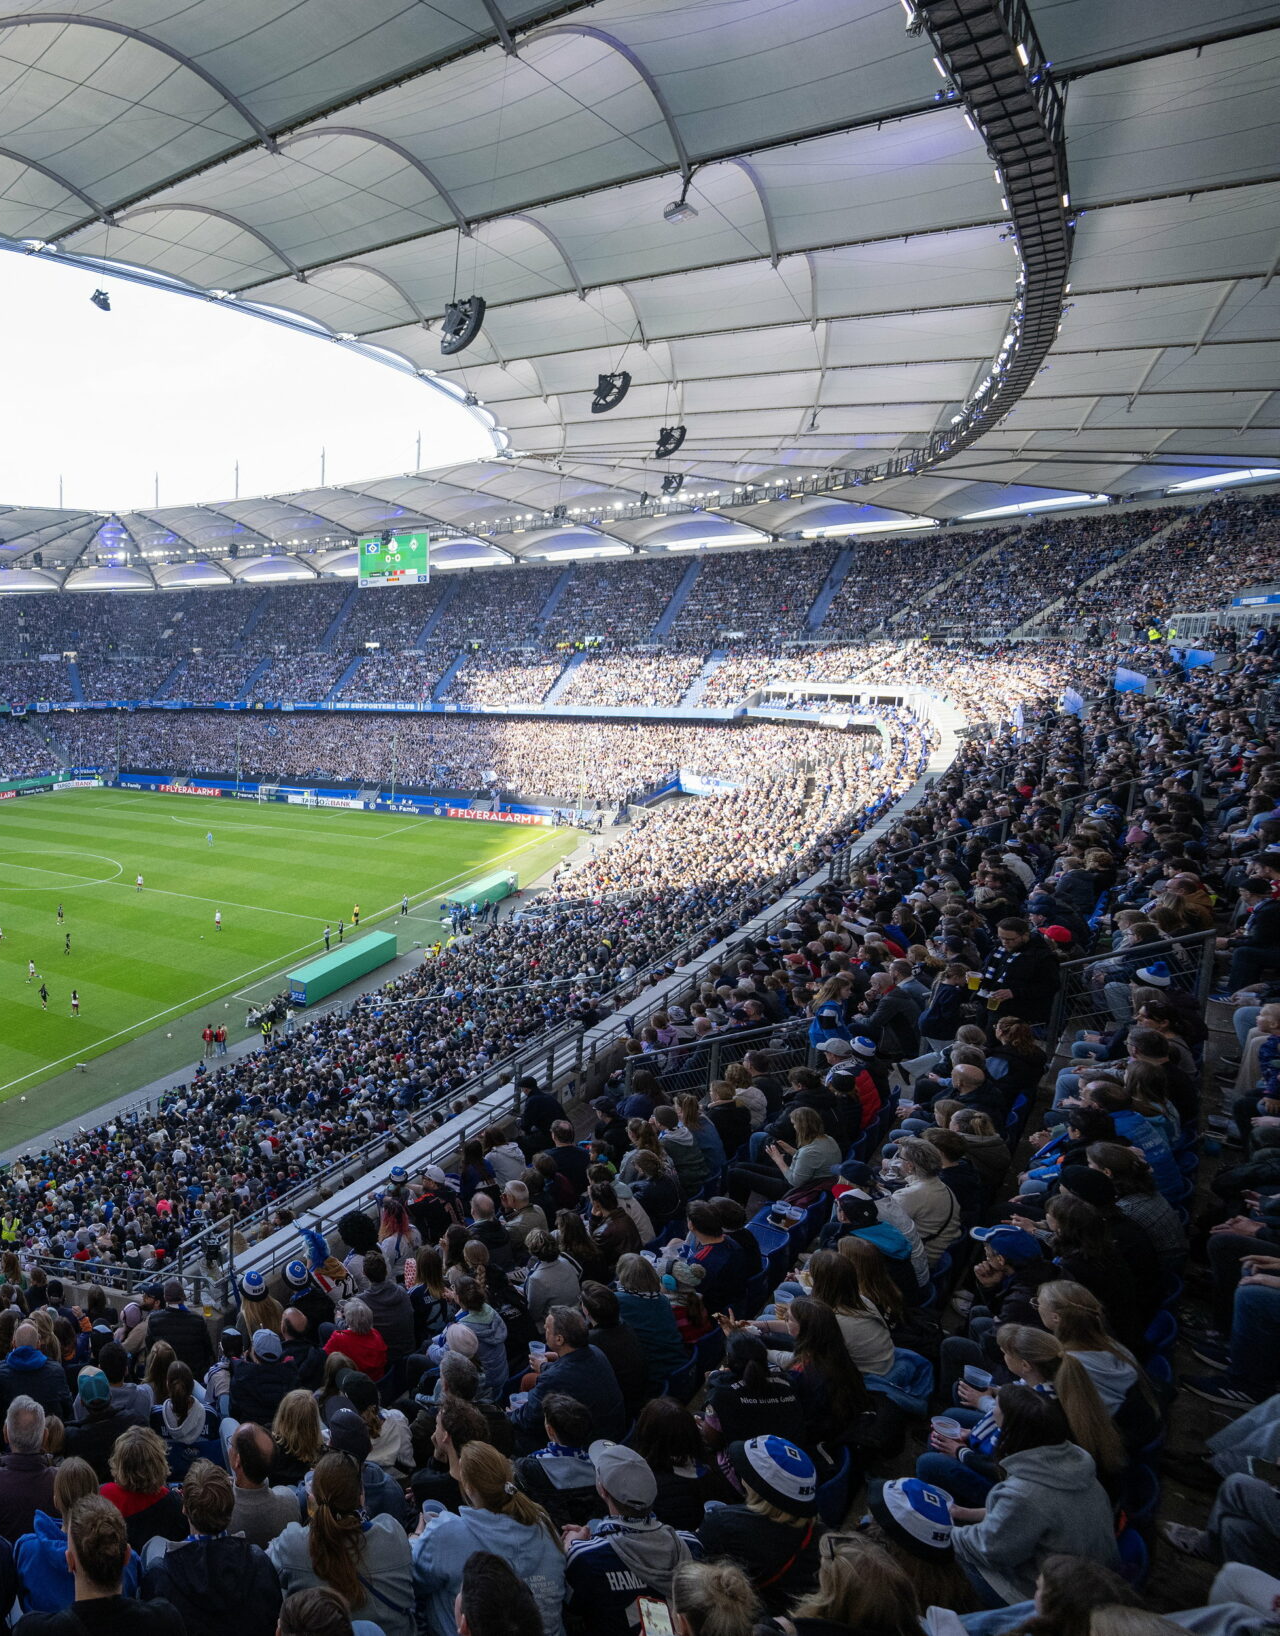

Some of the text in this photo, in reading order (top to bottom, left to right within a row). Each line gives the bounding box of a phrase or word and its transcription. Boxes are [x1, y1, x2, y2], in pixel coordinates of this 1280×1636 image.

[166, 784, 214, 796] FLYERALARM
[398, 804, 420, 814] Family
[458, 809, 532, 824] FLYERALARM
[740, 1396, 757, 1404] Nico
